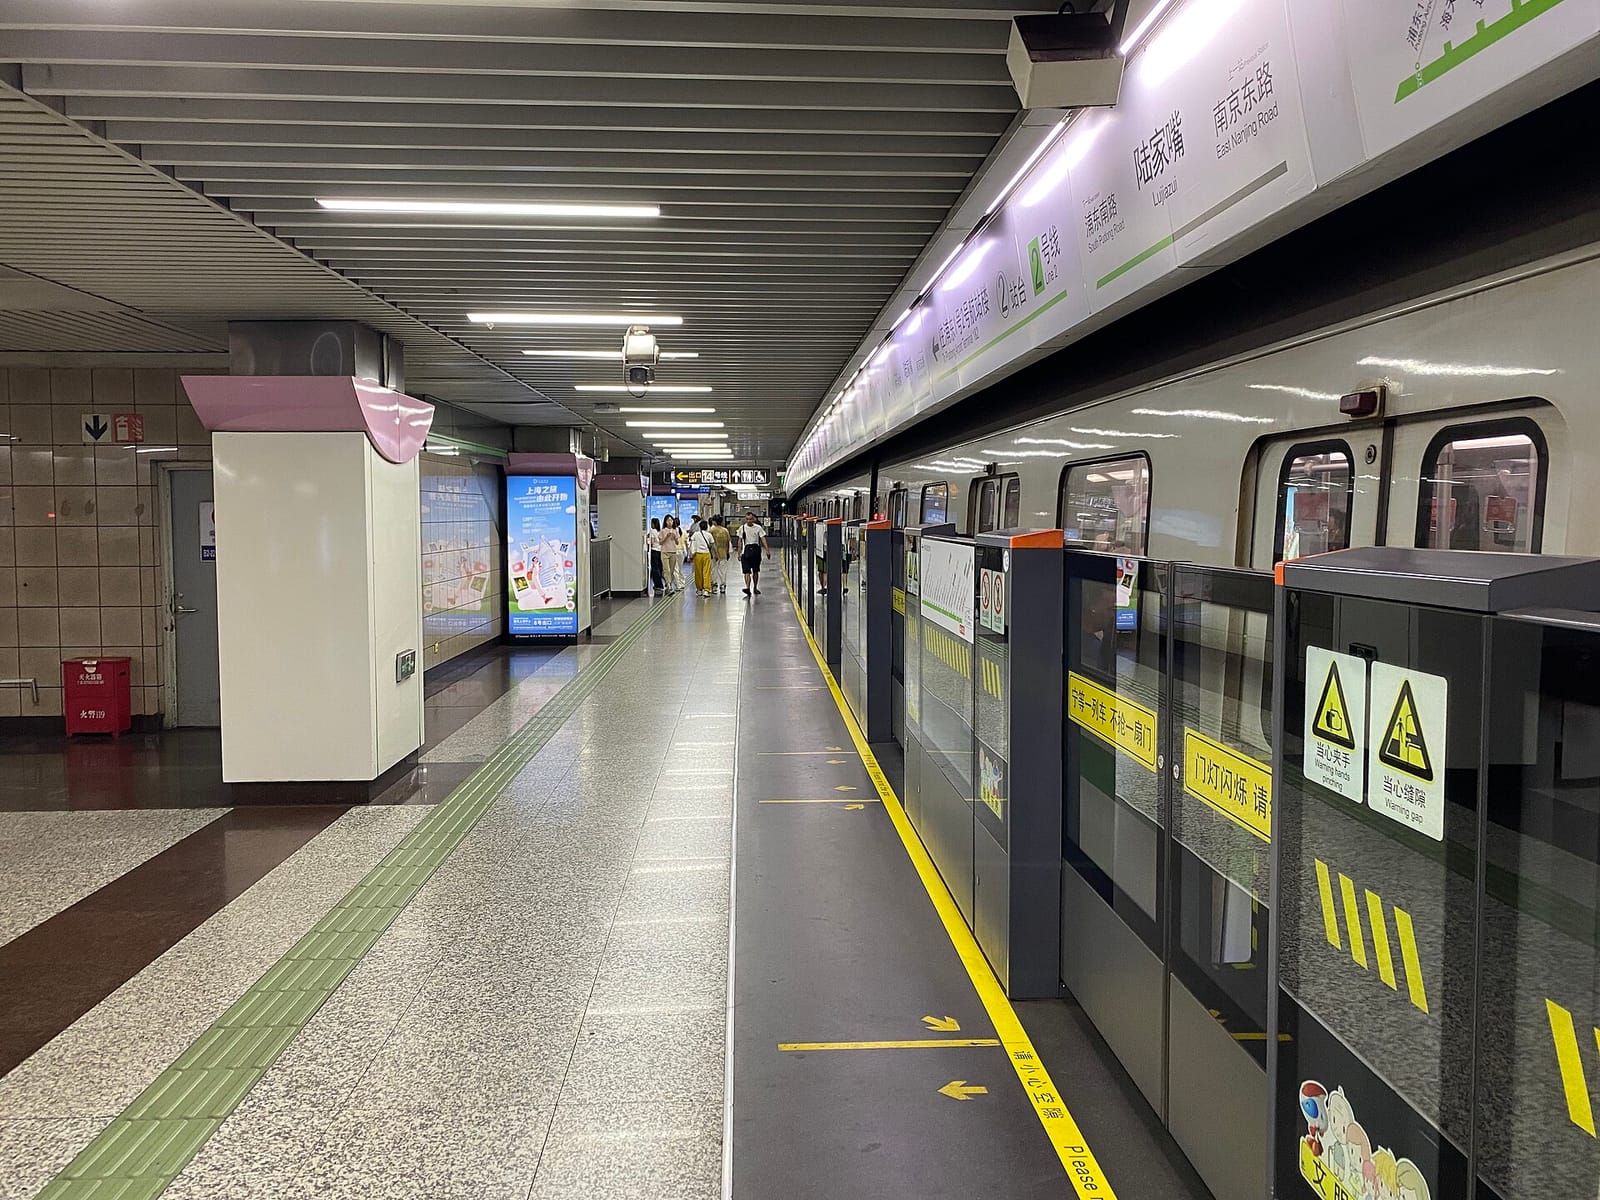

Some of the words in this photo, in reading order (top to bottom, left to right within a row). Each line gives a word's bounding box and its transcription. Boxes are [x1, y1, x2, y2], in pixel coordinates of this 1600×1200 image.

[1212, 61, 1274, 138] 南京东路
[1133, 109, 1185, 191] 陆家嘴
[1215, 141, 1231, 160] East
[1230, 120, 1257, 149] Nanjing
[1257, 102, 1279, 125] Road
[1151, 175, 1178, 206] Lujiazui
[1071, 687, 1107, 725] 宁等一列车
[1109, 706, 1152, 751] 不抢一扇门
[1314, 757, 1335, 777] Warning
[1334, 766, 1350, 783] hands
[1316, 740, 1351, 769] 当心夹手
[1195, 752, 1248, 806] 门灯闪烁
[1252, 782, 1272, 820] 请
[1322, 774, 1344, 792] pinching
[1383, 775, 1426, 808] 当心缝隙
[1384, 796, 1410, 819] Warning
[1410, 808, 1424, 824] gap
[1013, 1050, 1065, 1120] 请小心空隙
[1063, 1145, 1099, 1192] Please
